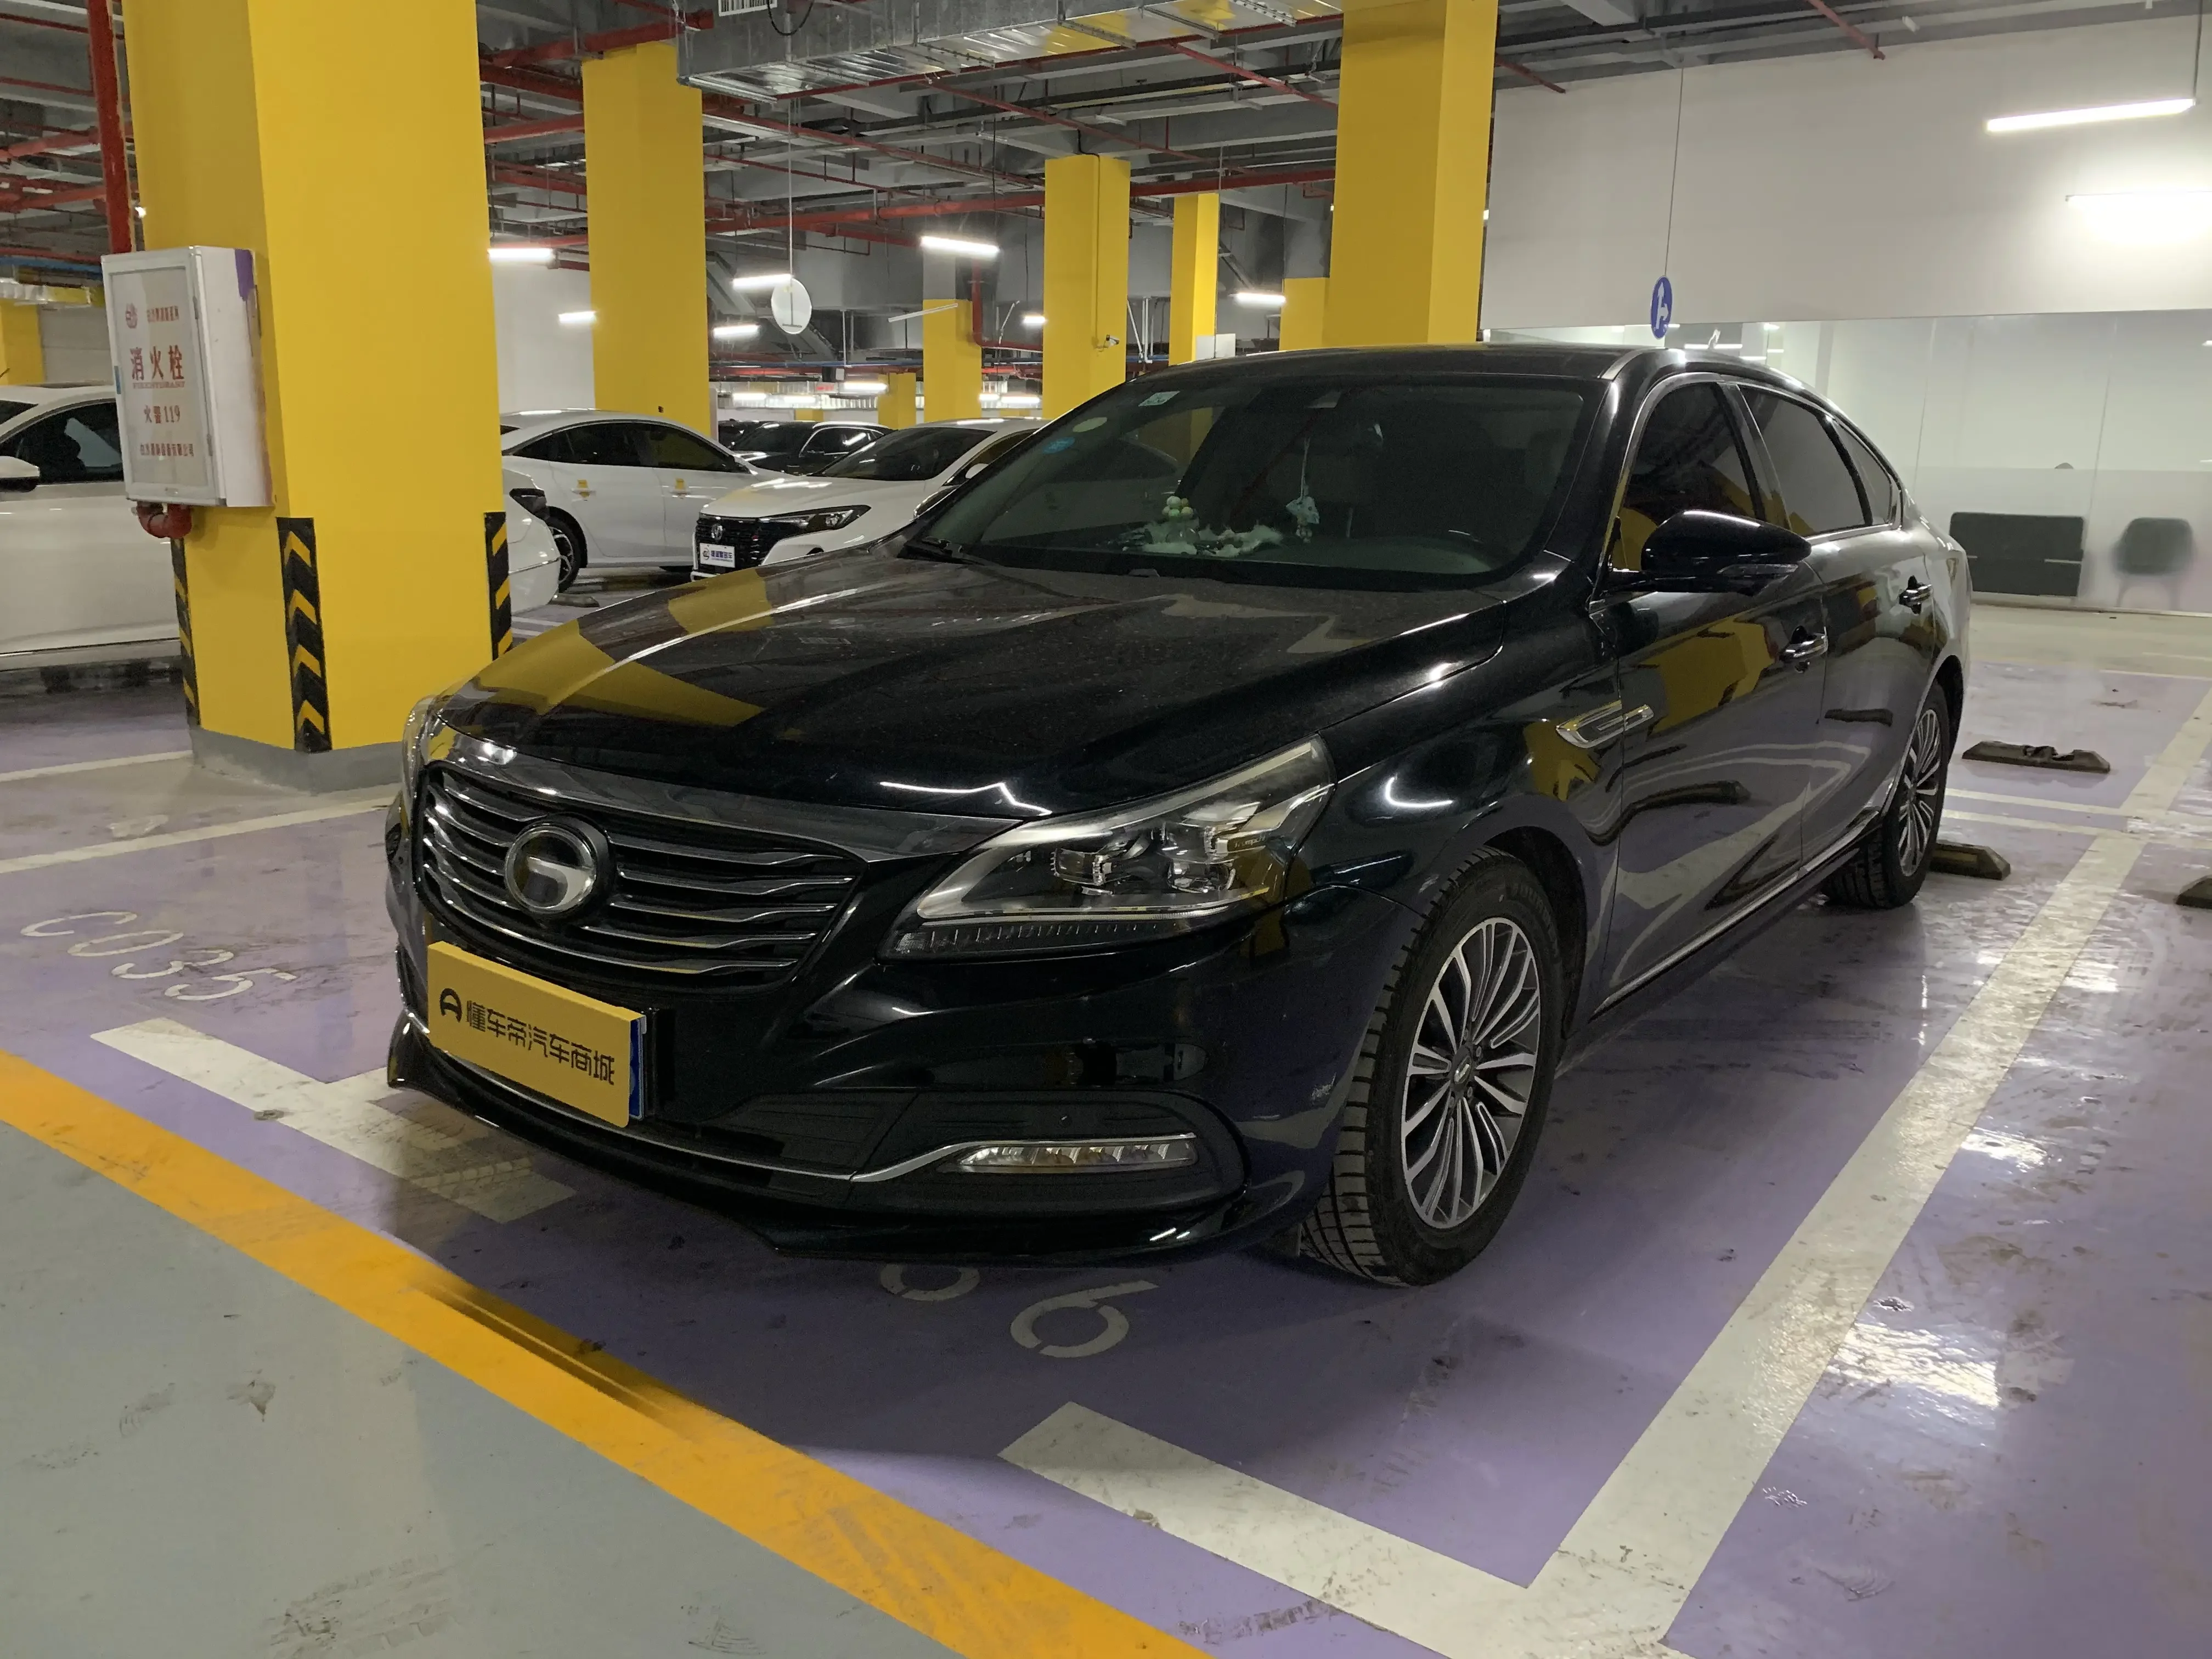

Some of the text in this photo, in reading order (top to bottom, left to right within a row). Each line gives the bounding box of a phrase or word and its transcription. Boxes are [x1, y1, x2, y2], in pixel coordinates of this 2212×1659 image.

[129, 345, 184, 380] 消火栓
[465, 999, 615, 1086] 懂车帝汽车商城
